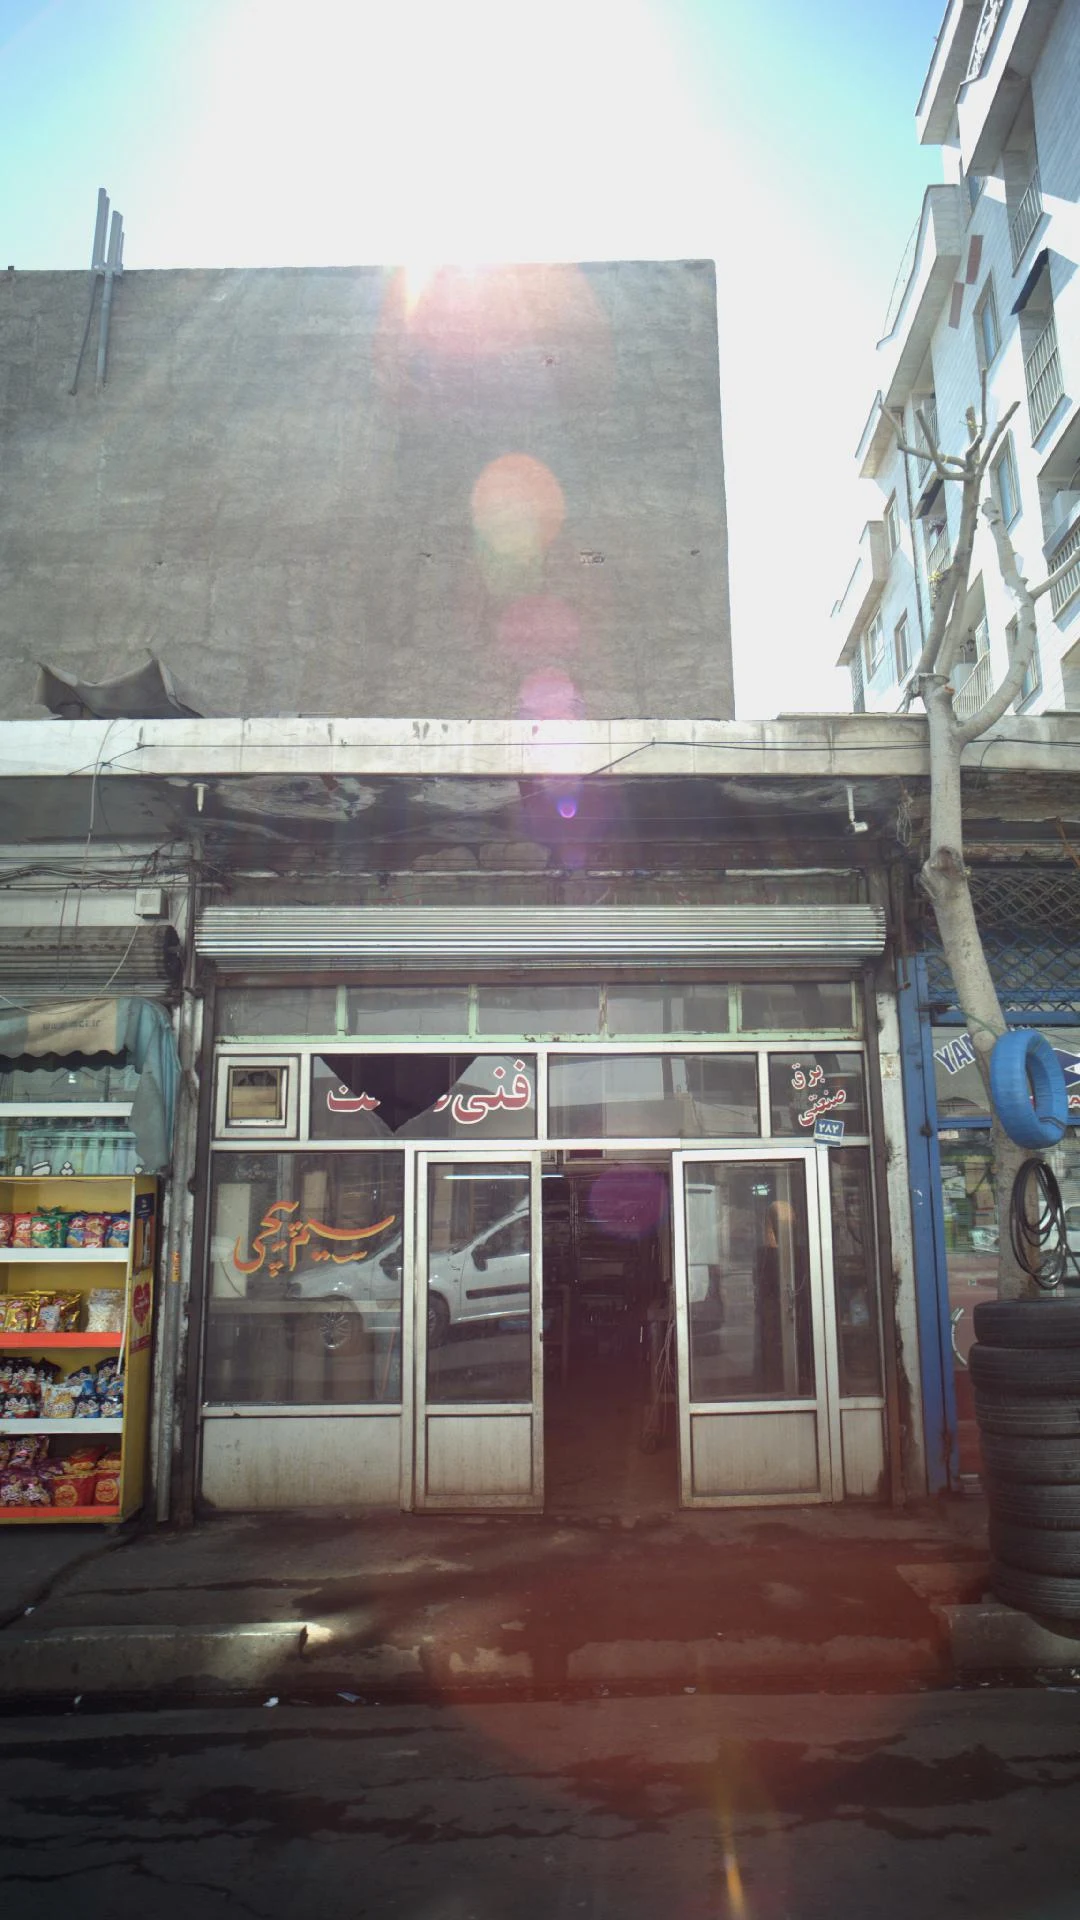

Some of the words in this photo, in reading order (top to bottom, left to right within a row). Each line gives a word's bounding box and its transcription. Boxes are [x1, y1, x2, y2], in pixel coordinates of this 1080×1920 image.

[452, 1059, 531, 1124] فنی
[791, 1062, 826, 1090] برق
[798, 1089, 847, 1127] صنعتی
